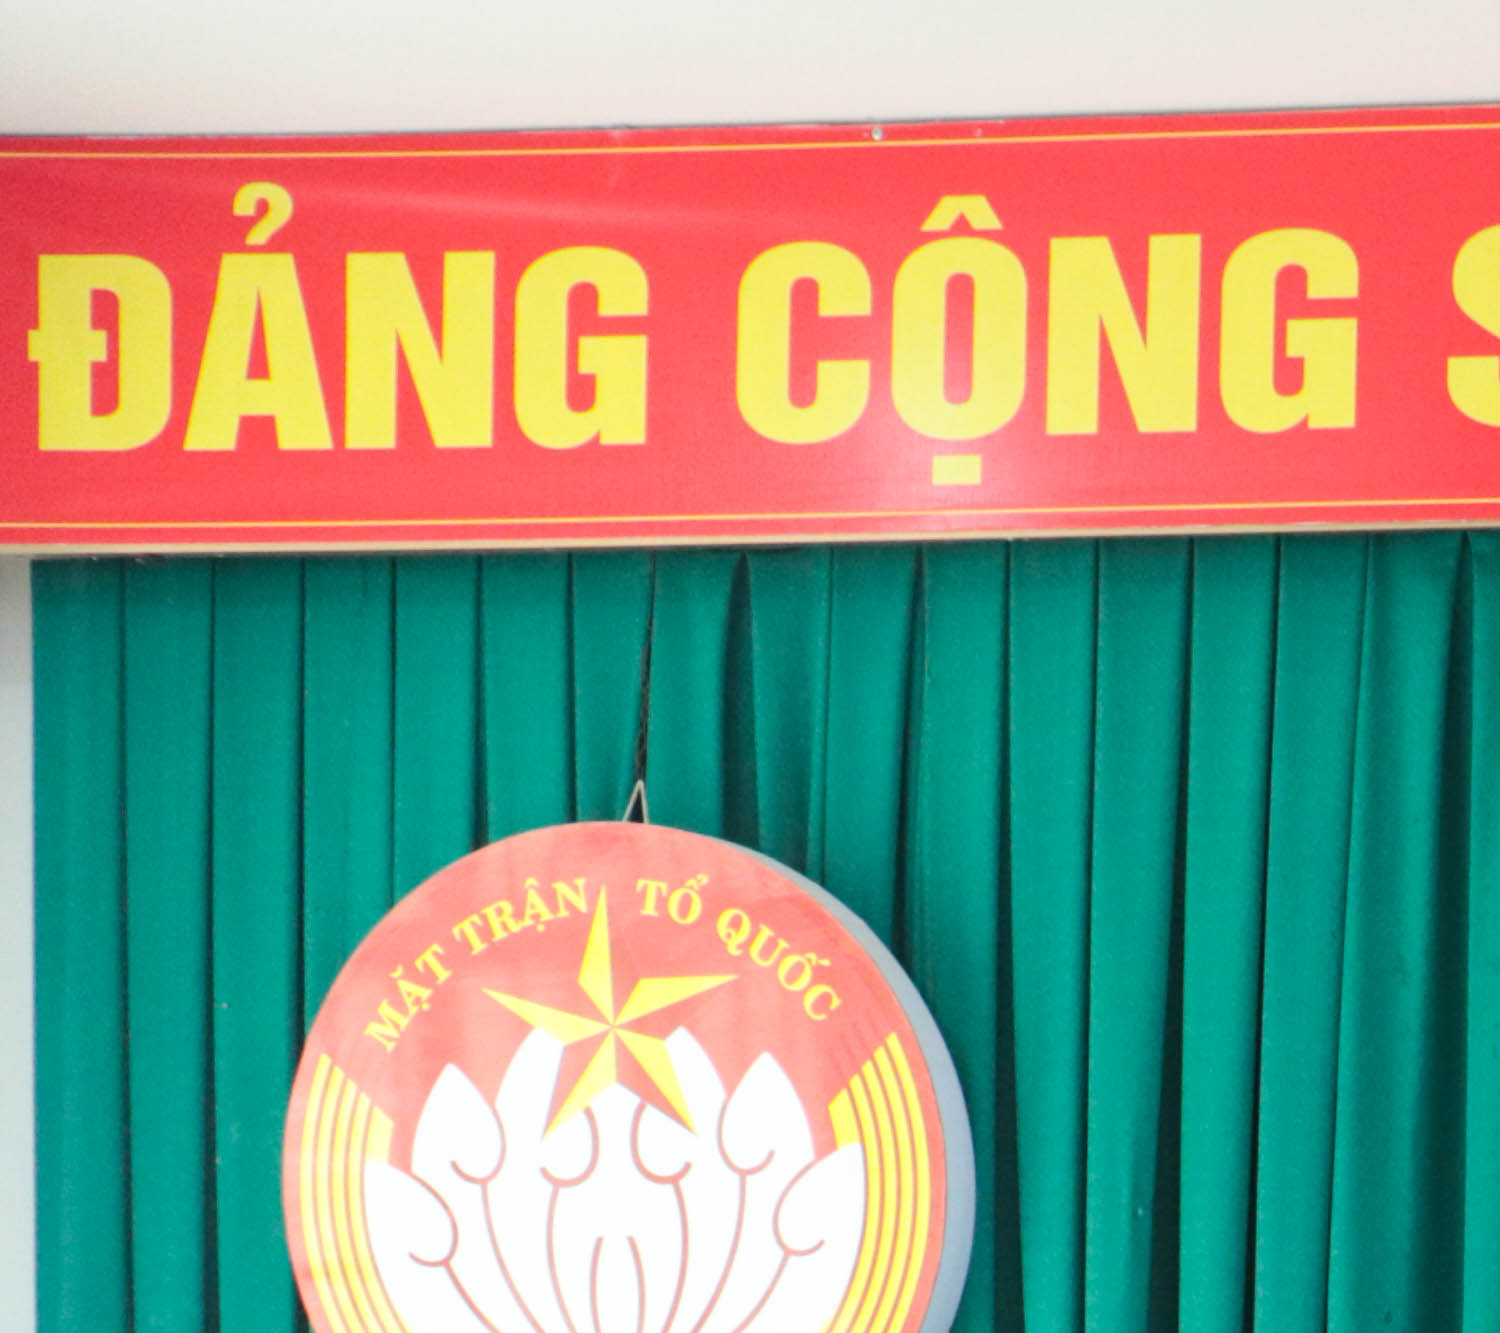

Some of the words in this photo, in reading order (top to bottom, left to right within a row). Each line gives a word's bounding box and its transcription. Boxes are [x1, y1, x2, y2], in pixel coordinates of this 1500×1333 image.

[28, 184, 649, 451] ĐẢNG
[734, 195, 1360, 488] CỘNG
[364, 943, 452, 1052] MẶT
[452, 876, 588, 956] TRẬN
[636, 873, 710, 925] TỔ
[716, 908, 842, 1021] QUỐC
